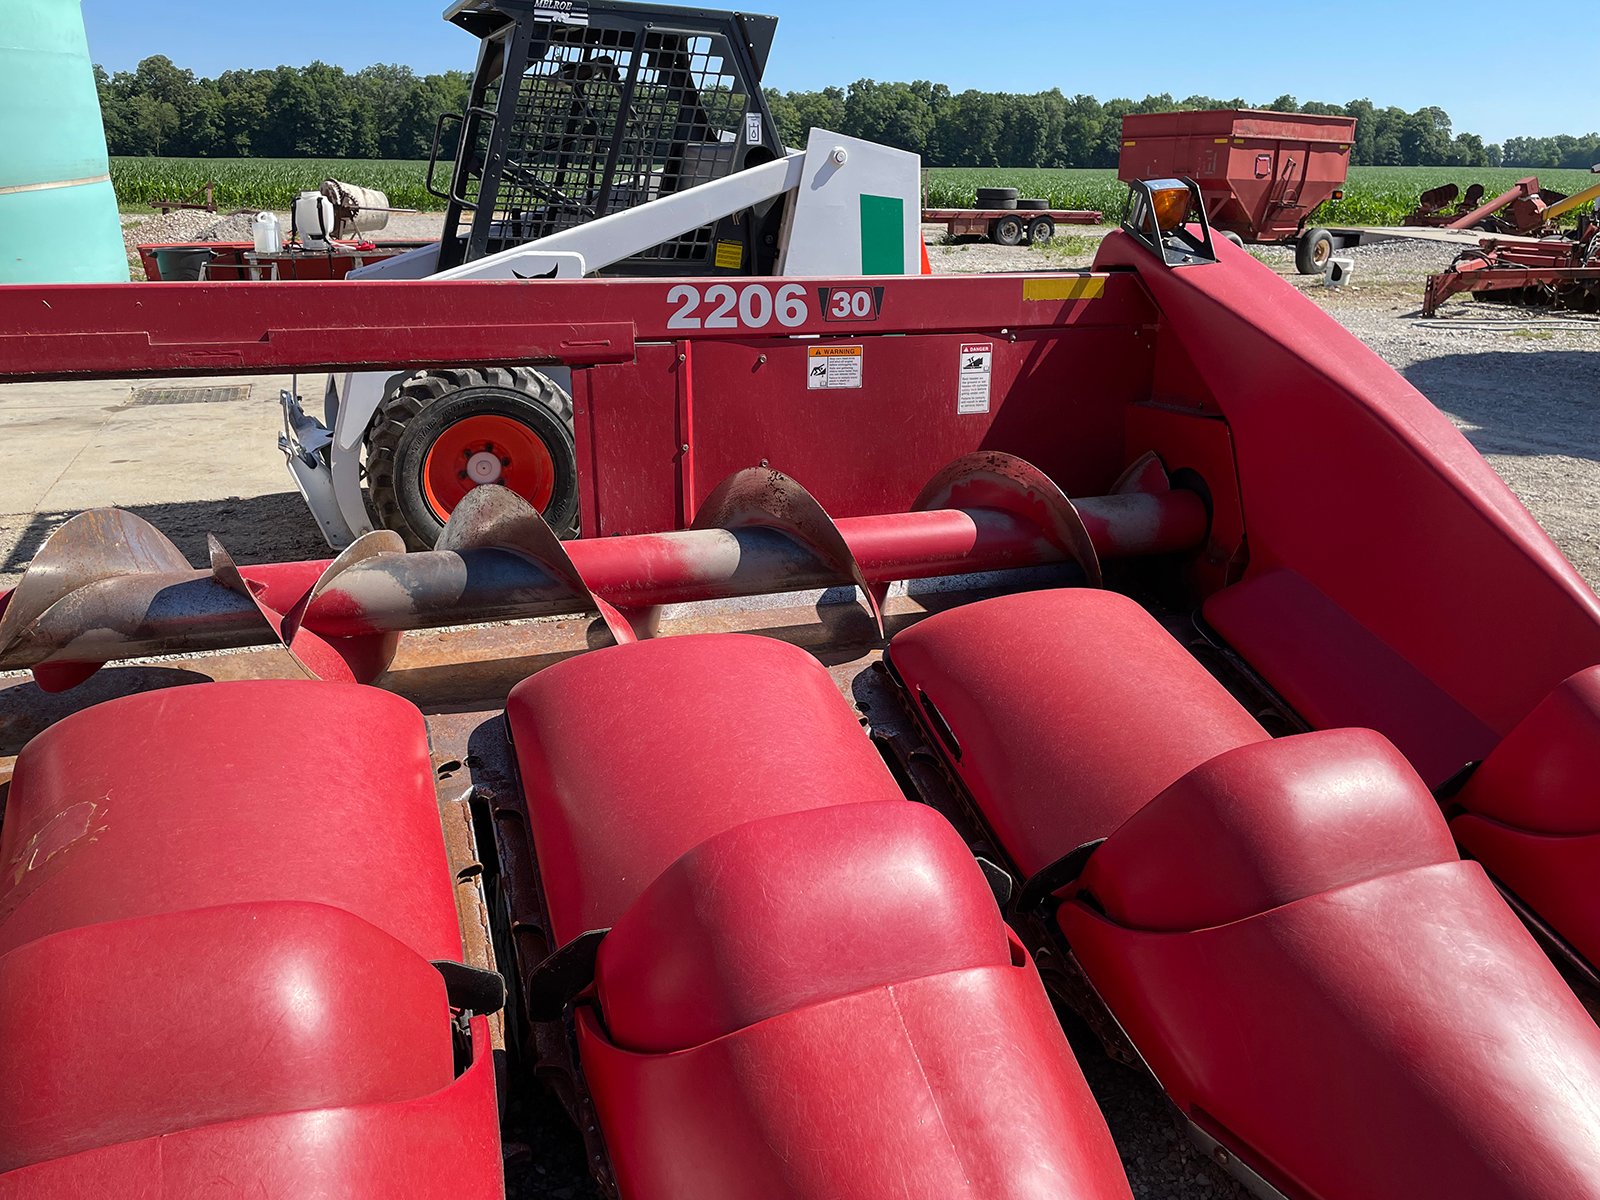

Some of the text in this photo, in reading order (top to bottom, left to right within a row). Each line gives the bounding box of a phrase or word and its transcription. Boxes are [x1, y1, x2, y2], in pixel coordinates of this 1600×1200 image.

[534, 0, 572, 10] MELROE
[666, 283, 872, 329] 2206 30
